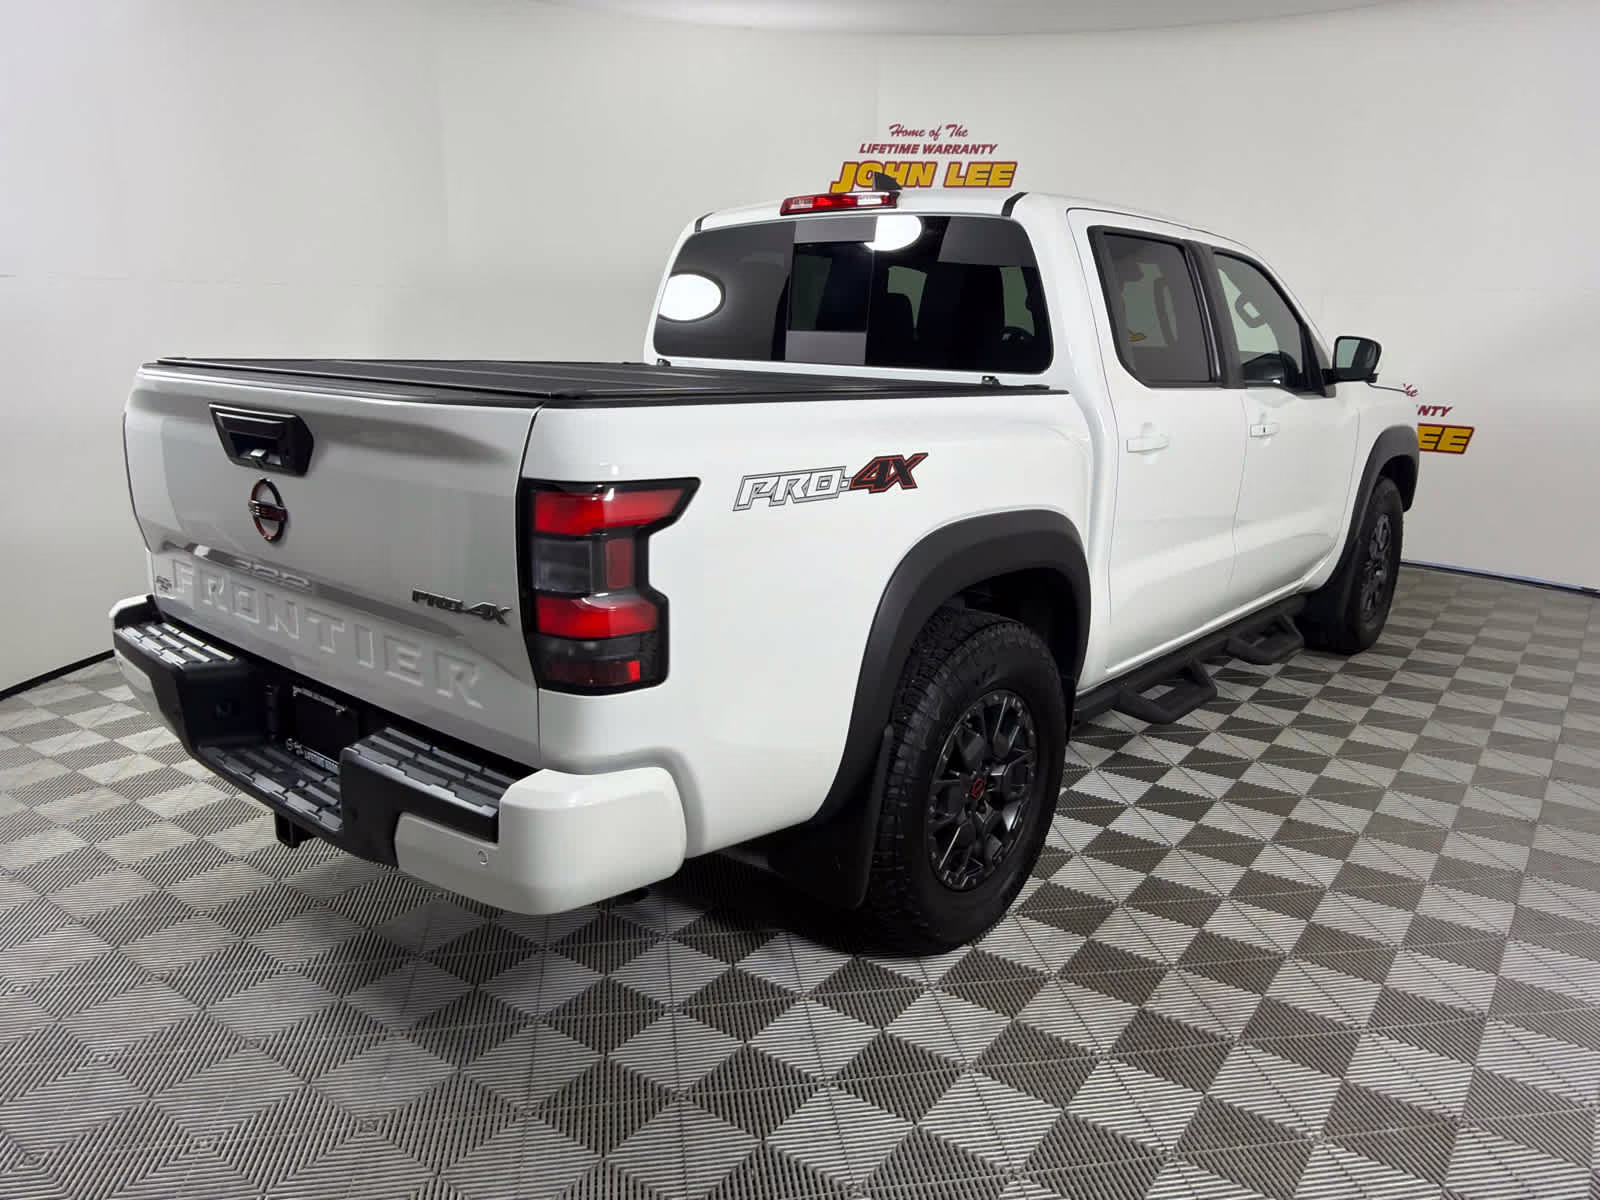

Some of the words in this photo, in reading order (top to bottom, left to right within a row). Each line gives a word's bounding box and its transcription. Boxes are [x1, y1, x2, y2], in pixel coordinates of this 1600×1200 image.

[859, 143, 920, 154] LIFETIME
[922, 143, 998, 154] WARRANTY
[889, 124, 925, 137] Home
[928, 127, 942, 141] of
[945, 124, 969, 137] The
[829, 160, 938, 194] JOHN
[943, 161, 1018, 188] LEE
[1417, 423, 1475, 455] EE
[733, 452, 929, 511] PRO-4X
[172, 559, 484, 710] FRONTIER
